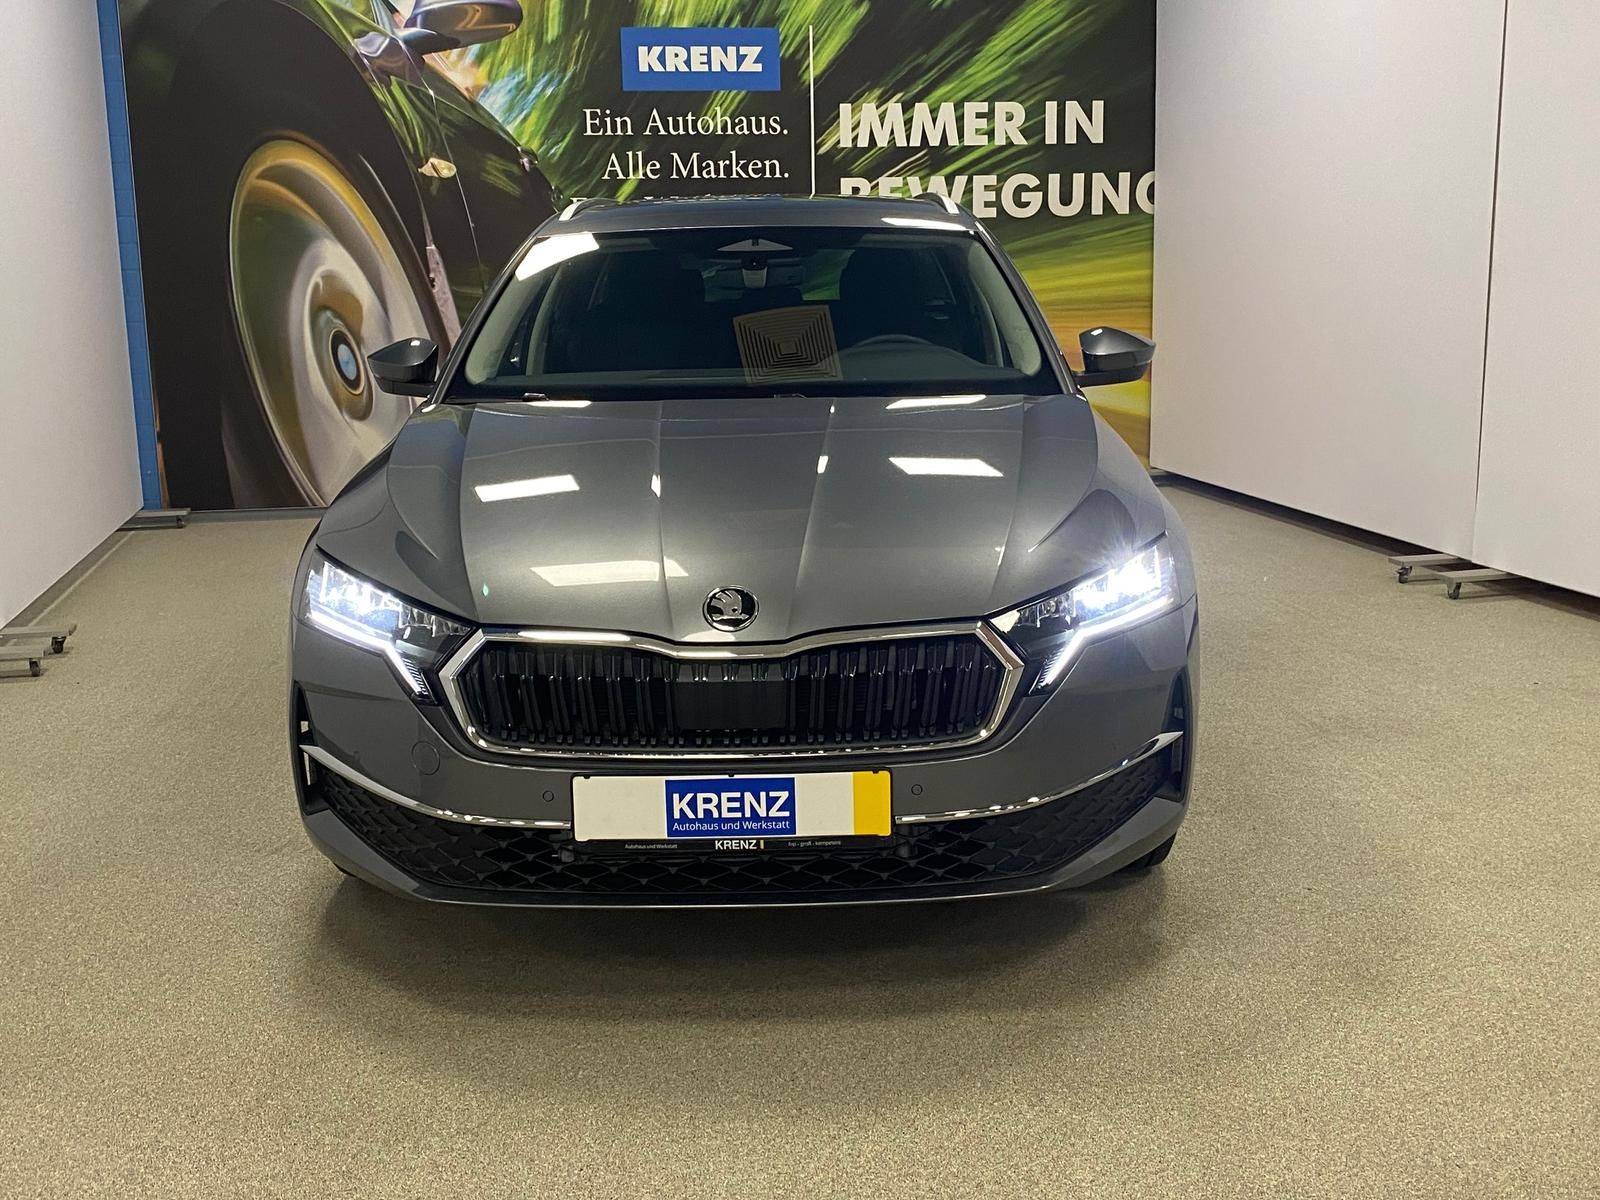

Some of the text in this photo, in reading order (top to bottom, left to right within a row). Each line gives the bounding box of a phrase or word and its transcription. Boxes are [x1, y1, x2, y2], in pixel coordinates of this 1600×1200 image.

[637, 46, 763, 72] KRENZ
[582, 107, 789, 136] Ein Autohaus.
[839, 100, 1105, 148] IMMER IN
[601, 150, 789, 180] Alle Marken.
[672, 791, 791, 819] KRENZ
[672, 820, 791, 831] Autohaus und Werkstatt
[714, 839, 758, 850] KRENZ
